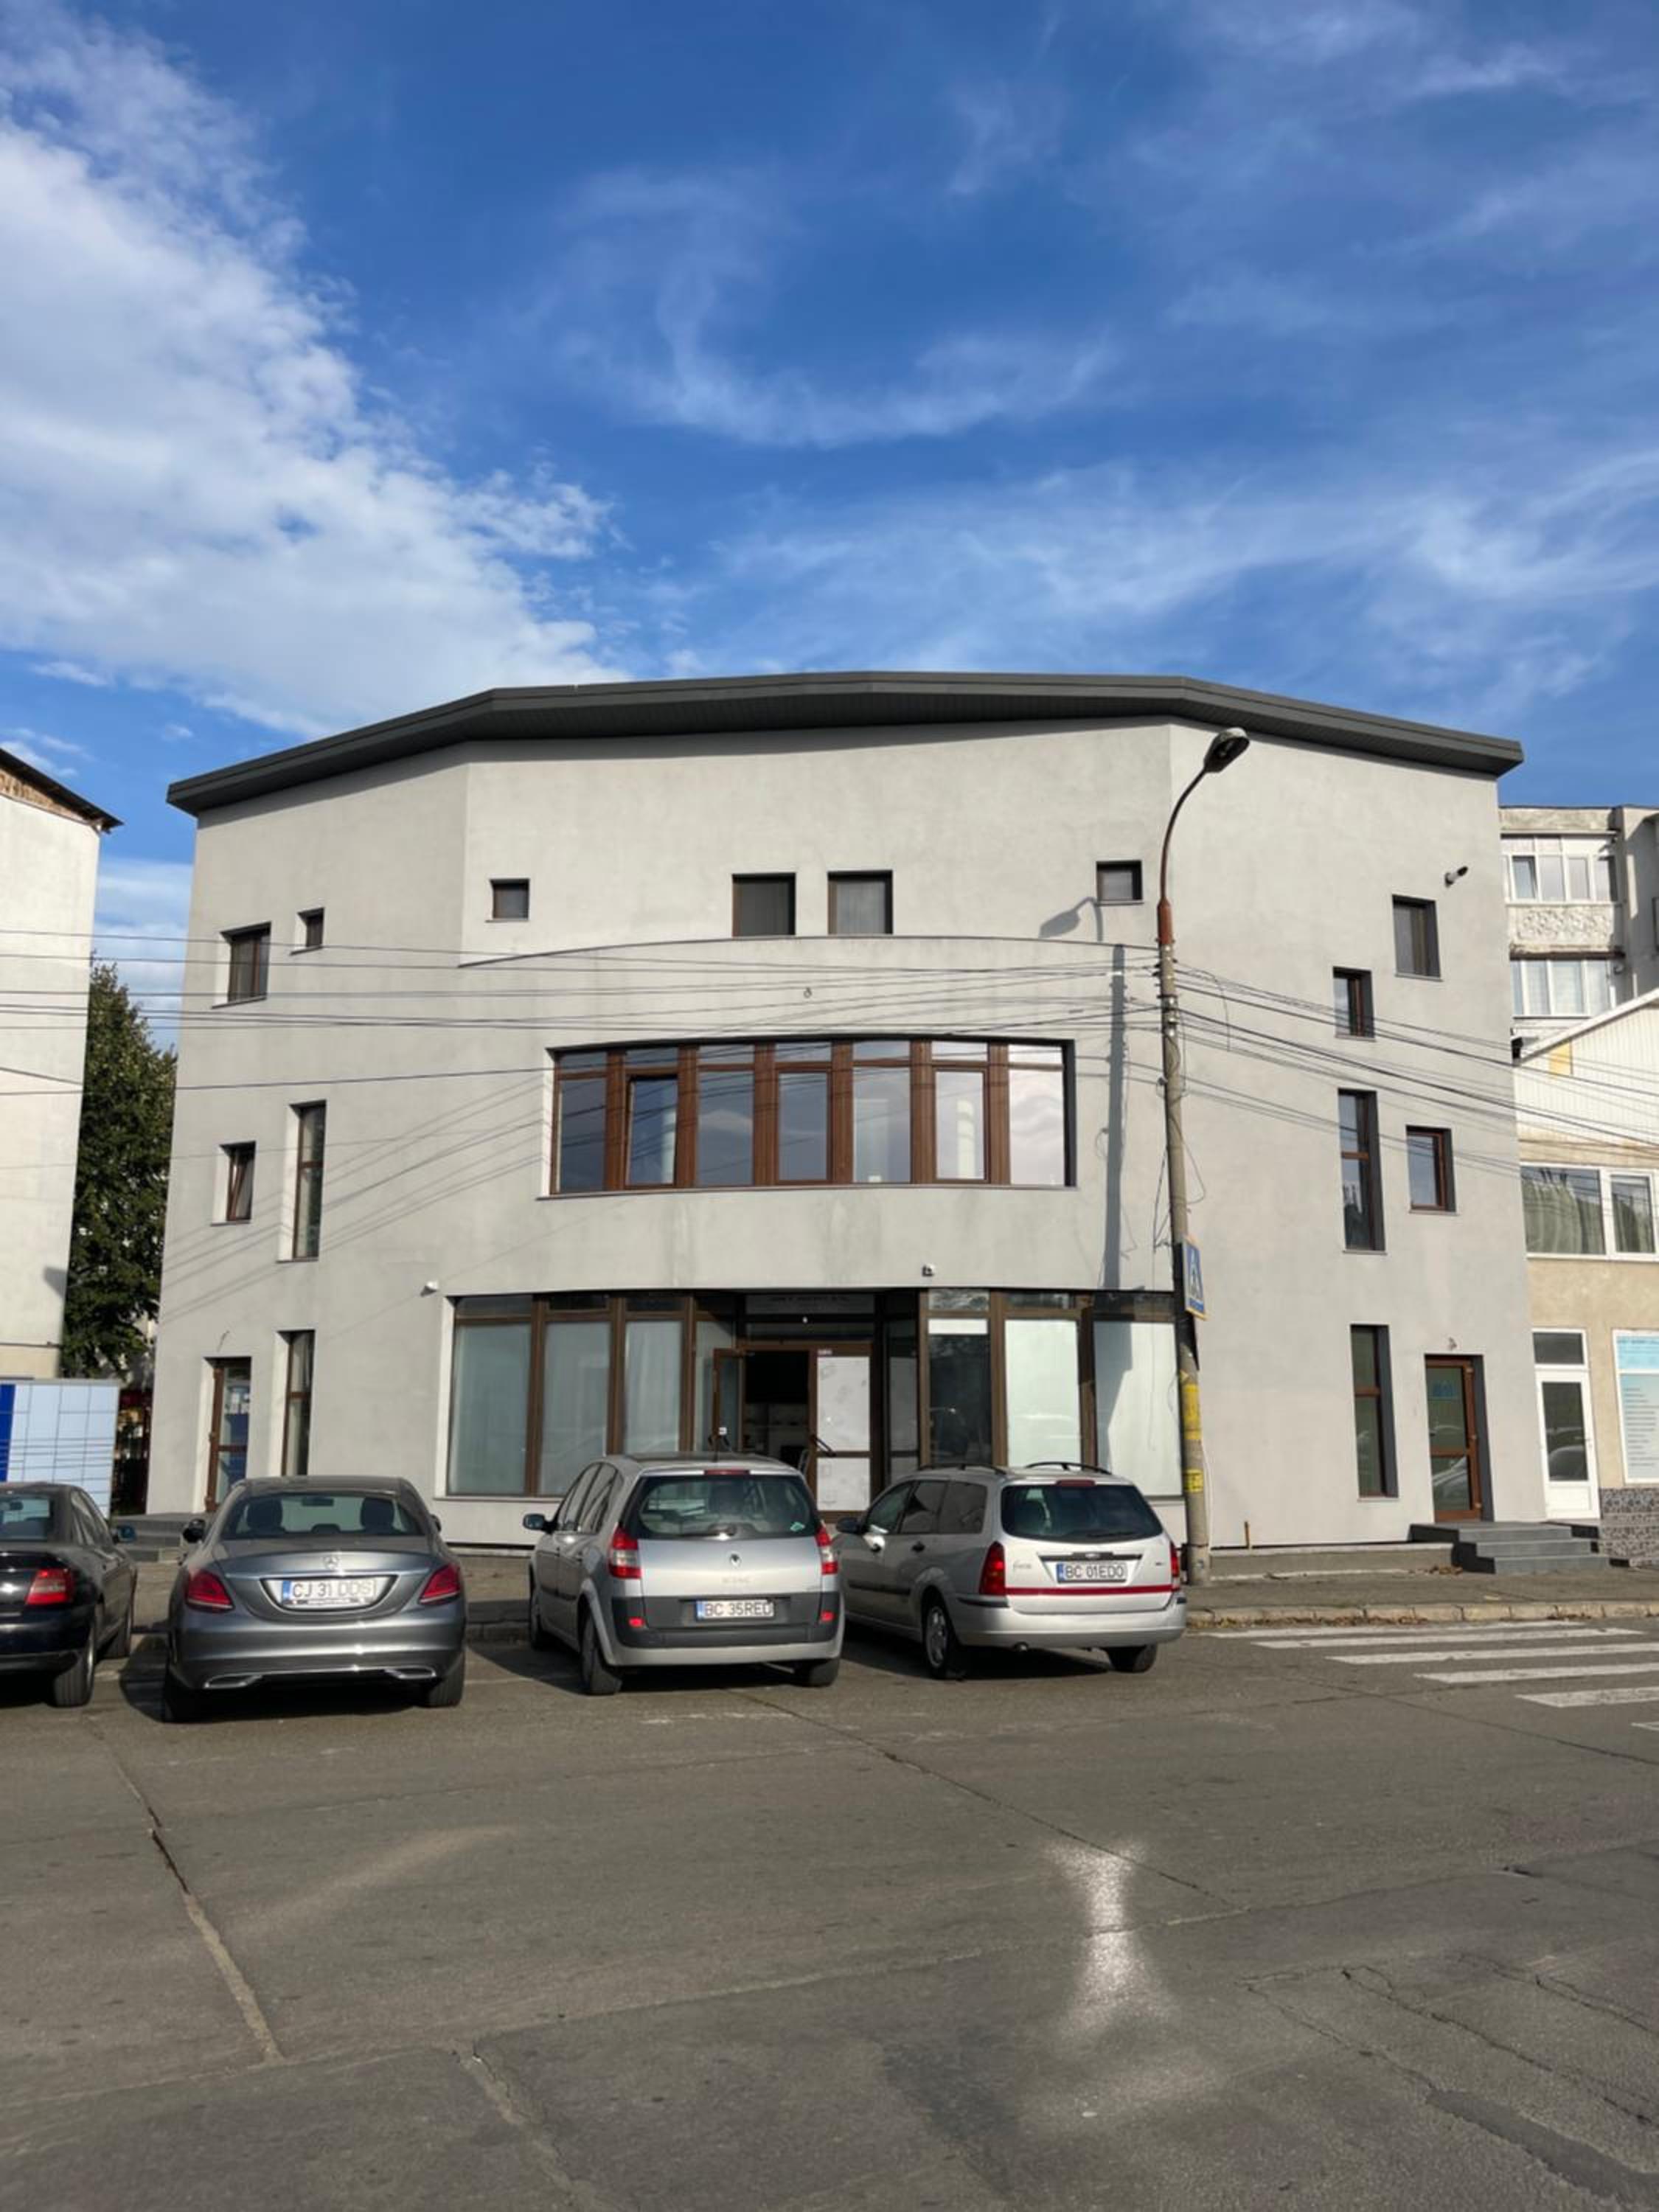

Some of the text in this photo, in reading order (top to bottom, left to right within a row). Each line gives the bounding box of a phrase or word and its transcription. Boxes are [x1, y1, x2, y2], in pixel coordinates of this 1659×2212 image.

[1066, 1565, 1082, 1578] BC
[293, 1582, 312, 1598] CJ
[318, 1582, 331, 1597] 31
[705, 1603, 723, 1616] BC
